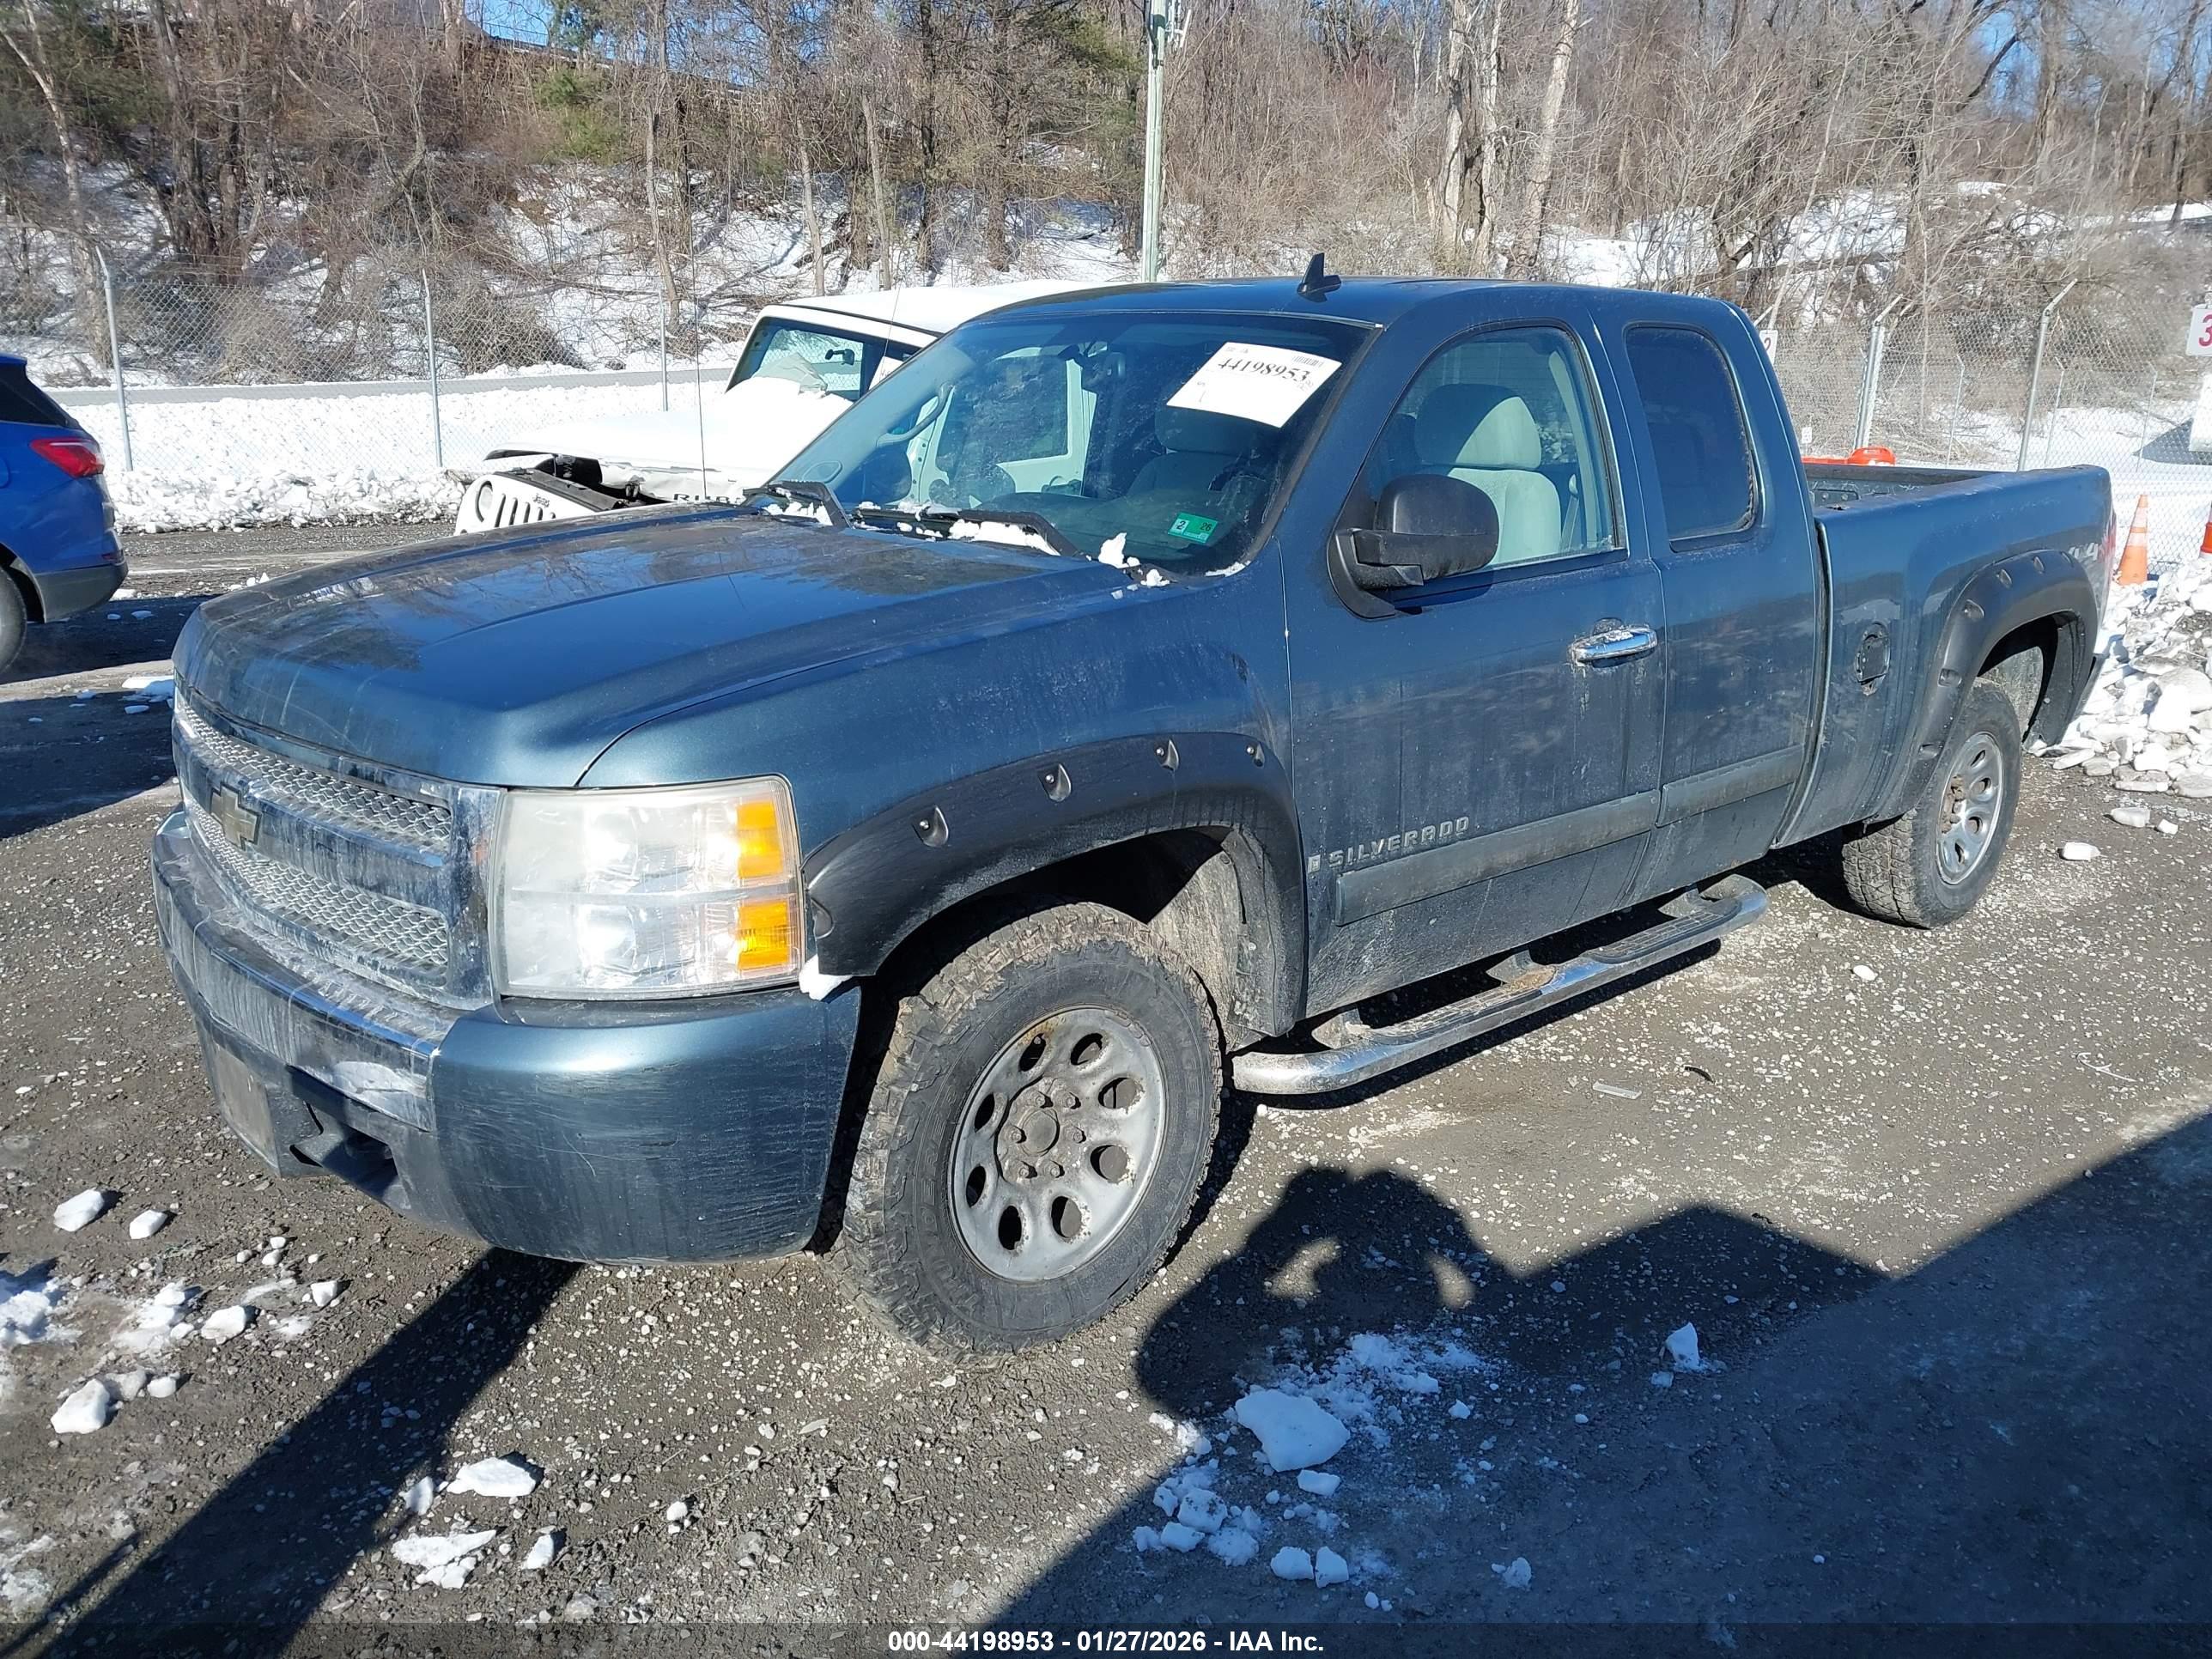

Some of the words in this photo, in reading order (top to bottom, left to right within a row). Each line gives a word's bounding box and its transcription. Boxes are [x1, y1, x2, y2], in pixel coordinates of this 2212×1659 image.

[1218, 356, 1311, 383] 44198953
[1176, 520, 1187, 531] 2
[1200, 522, 1212, 532] 26
[1328, 816, 1470, 869] SILVERADO
